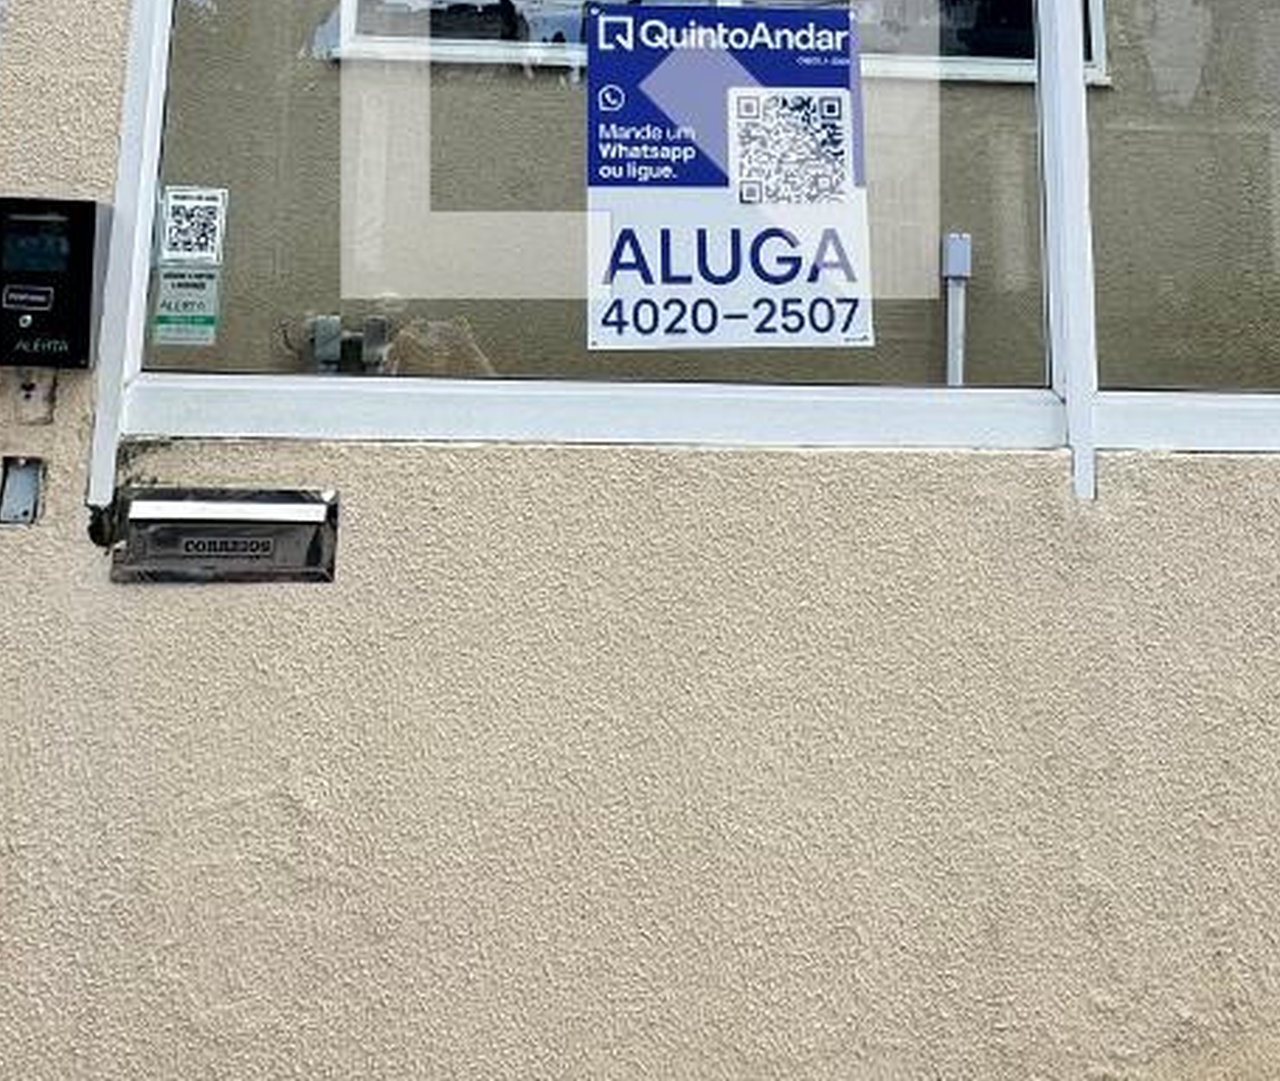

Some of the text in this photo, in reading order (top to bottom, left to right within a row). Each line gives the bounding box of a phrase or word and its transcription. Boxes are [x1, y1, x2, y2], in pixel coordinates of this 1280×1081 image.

[639, 20, 849, 53] QuintoAndar
[599, 123, 696, 140] Mande um
[599, 143, 696, 163] Whatsapp
[599, 161, 678, 182] ou ligue.
[603, 228, 857, 285] ALUGA
[601, 297, 860, 335] 4020-2507
[14, 337, 69, 353] ALERTA
